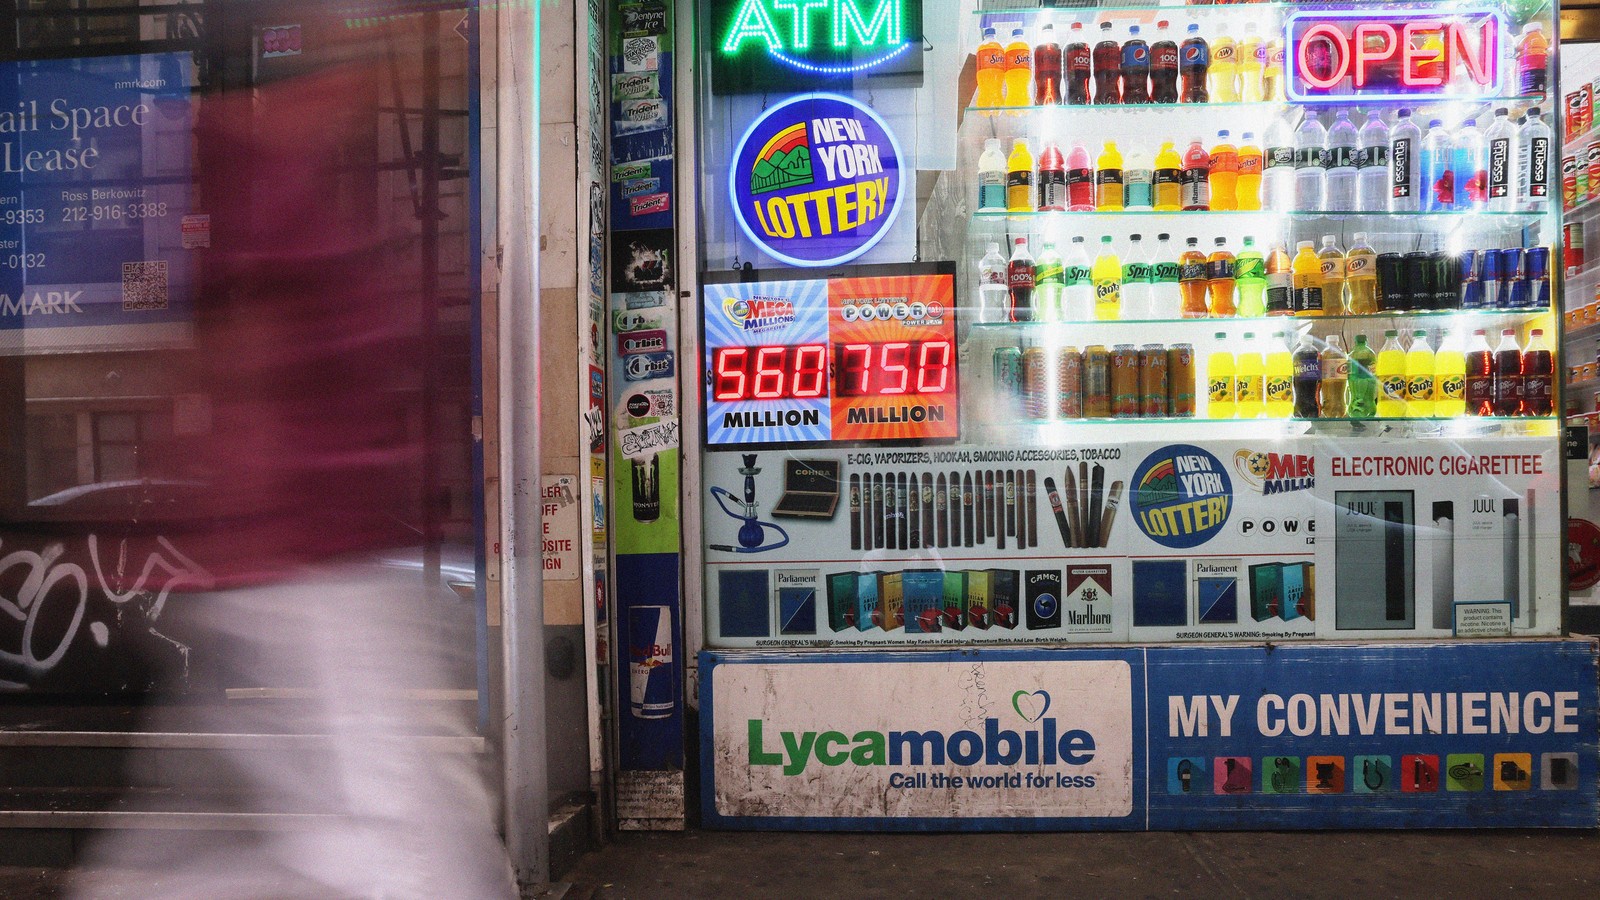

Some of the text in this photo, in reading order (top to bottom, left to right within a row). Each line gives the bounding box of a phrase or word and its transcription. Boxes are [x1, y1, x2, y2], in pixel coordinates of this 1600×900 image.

[723, 0, 903, 52] ATM
[1298, 21, 1494, 88] OPEN
[114, 77, 166, 89] nmrk.com
[619, 76, 650, 90] Trident
[628, 103, 660, 116] Trident
[50, 98, 150, 141] Space
[812, 118, 866, 145] NEW
[3, 142, 99, 173] Lease
[817, 144, 884, 182] YORK
[1395, 140, 1405, 183] essentia
[1493, 140, 1504, 183] essentia
[1534, 139, 1545, 182] essentia
[615, 168, 643, 179] Trident
[62, 188, 146, 202] Ross Berkowitz
[625, 182, 653, 194] Trident
[62, 202, 168, 223] 212-916-3388
[634, 198, 661, 212] Trident
[754, 177, 889, 239] LOTTERY
[1096, 281, 1120, 299] Fanta
[745, 300, 794, 319] MEGA
[843, 304, 923, 319] POWER
[744, 316, 795, 330] MILLIONS
[716, 345, 826, 400] 560
[845, 341, 951, 394] 750
[1267, 380, 1291, 395] Fanta
[1408, 379, 1433, 395] Fanta
[723, 409, 820, 428] MILLION
[847, 405, 945, 424] MILLION
[848, 448, 1121, 465] E-CIG, VAPORIZERS, HOOKAH, SMOKING ACCESSORIES, TOBACCO
[1176, 455, 1212, 473] NEW
[1332, 454, 1543, 477] ELECTRONIC CIGARETTEE
[1180, 473, 1224, 498] YORK
[1472, 499, 1496, 513] JUUL
[1140, 495, 1229, 537] LOTTERY
[1197, 563, 1238, 573] Parliament
[778, 573, 816, 583] Parliament
[1030, 573, 1060, 585] CAMEL
[1068, 604, 1111, 625] Marlboro
[1168, 691, 1579, 737] MY CONVENIENCE
[747, 718, 1097, 776] Lycamobile
[889, 772, 1096, 789] Call the world for less
